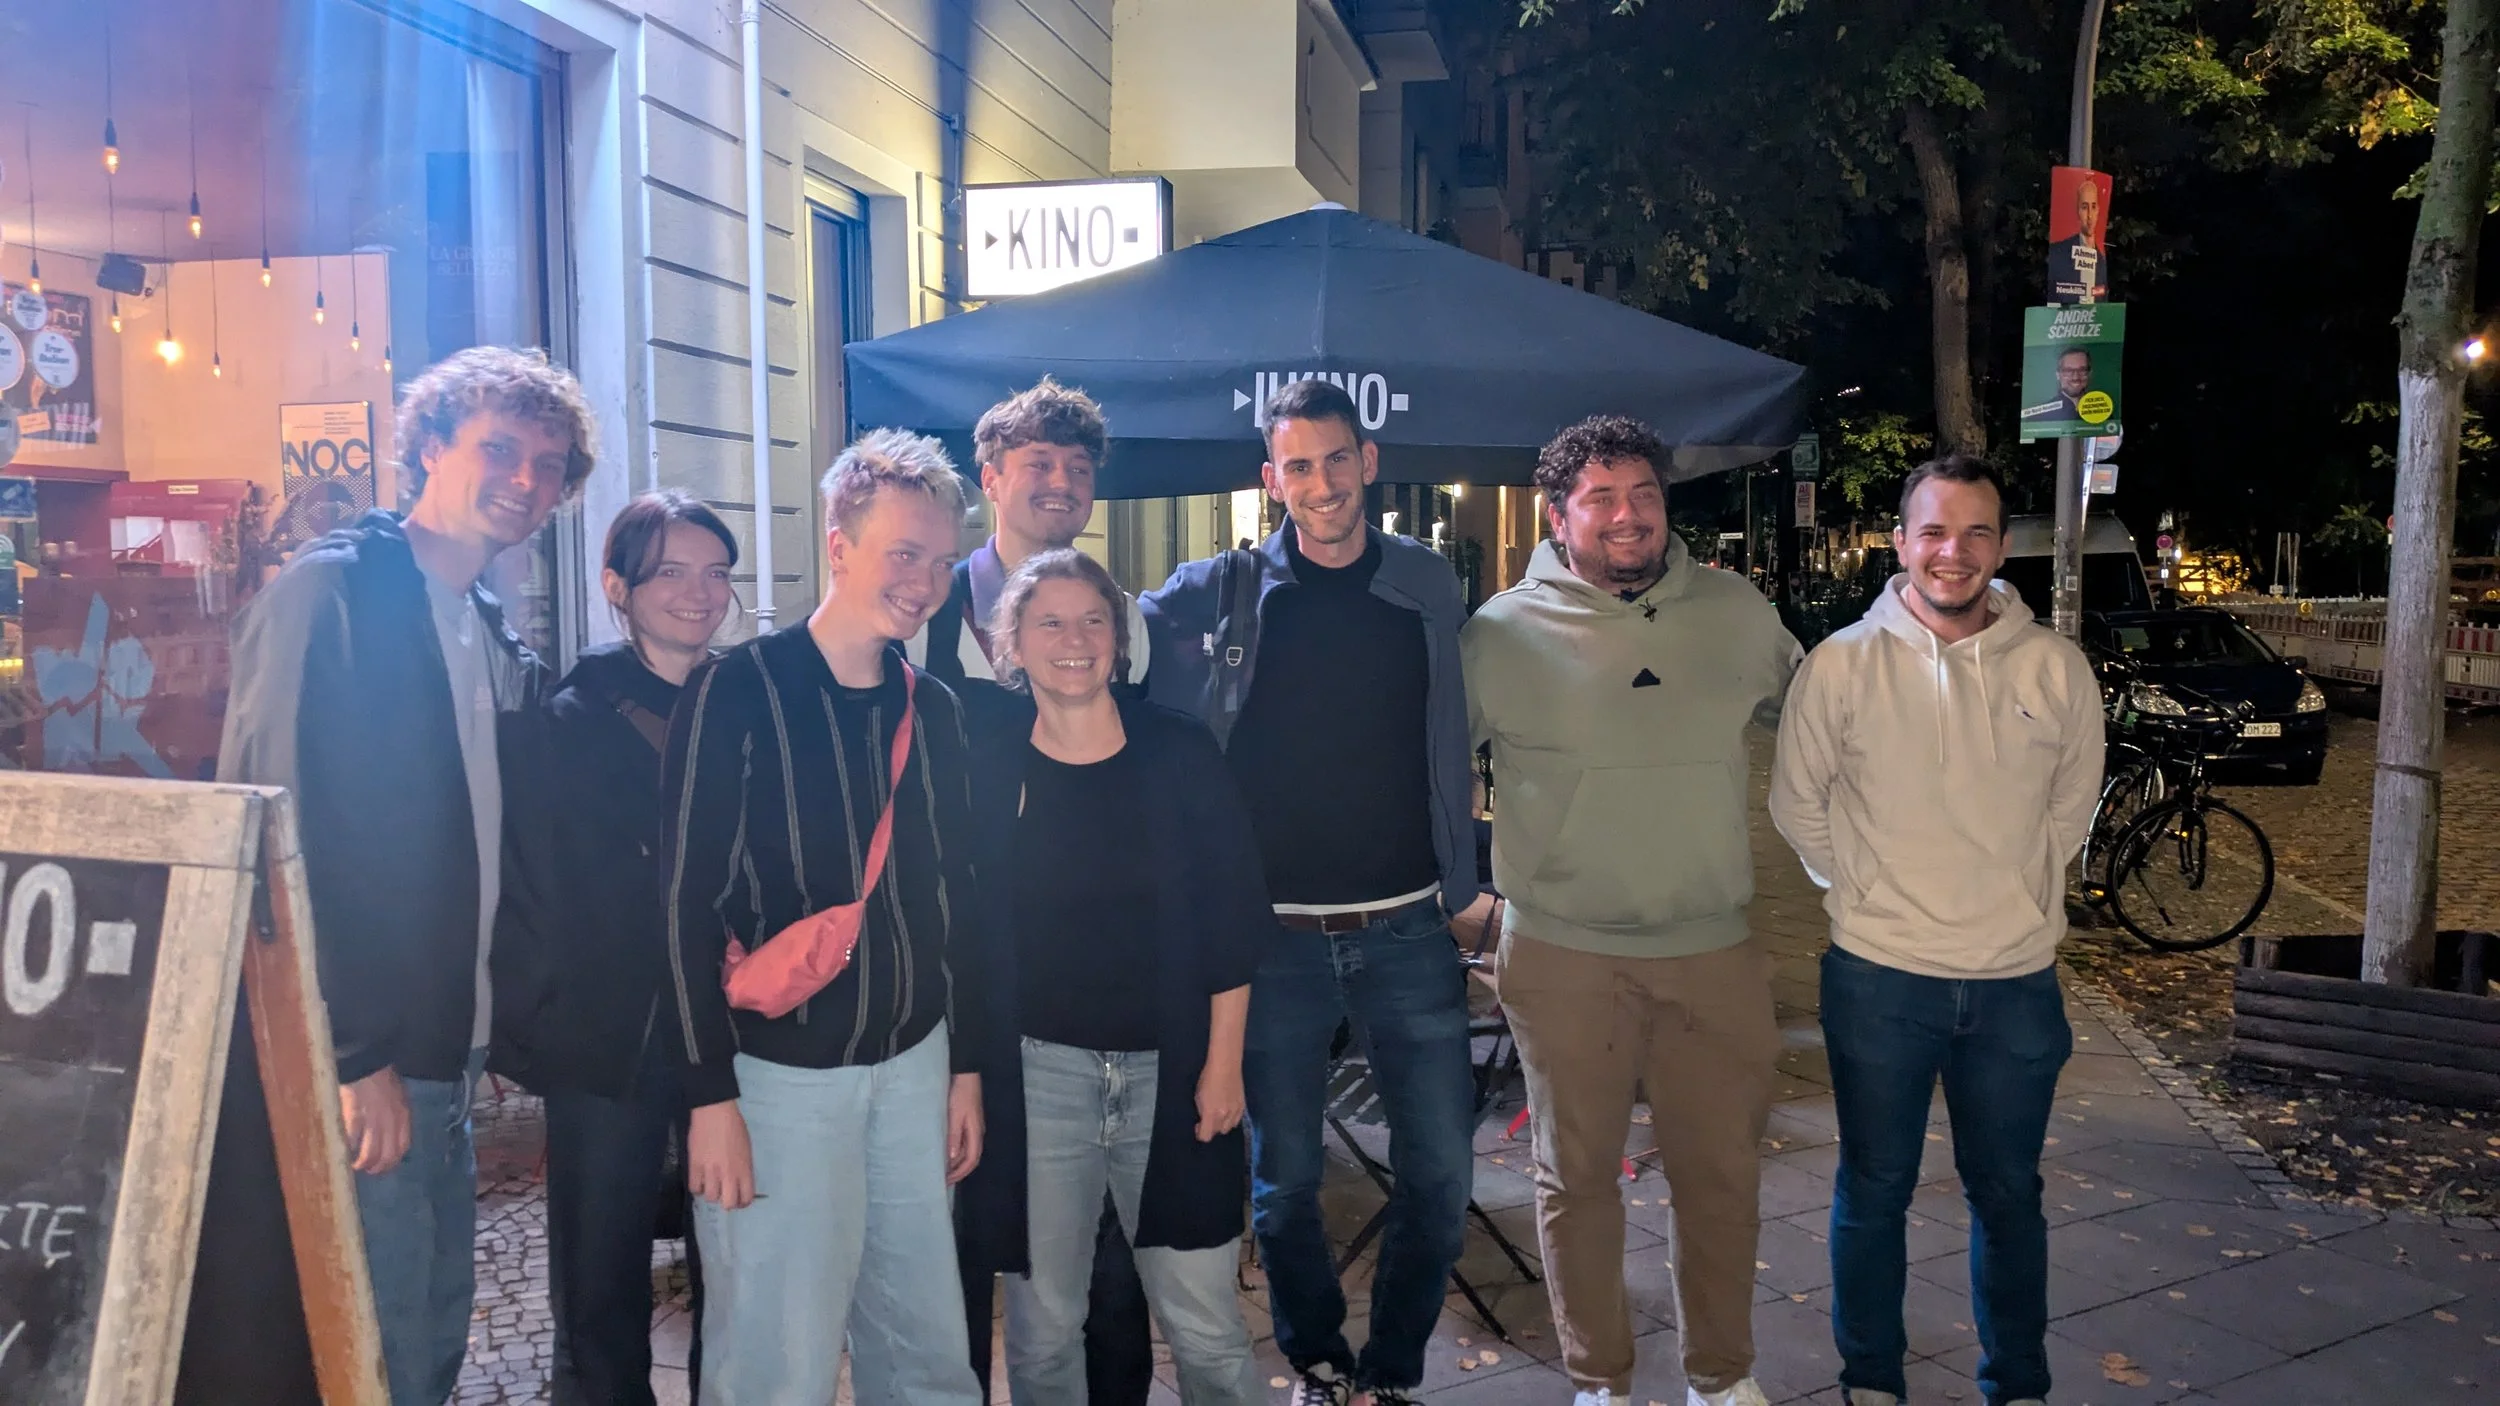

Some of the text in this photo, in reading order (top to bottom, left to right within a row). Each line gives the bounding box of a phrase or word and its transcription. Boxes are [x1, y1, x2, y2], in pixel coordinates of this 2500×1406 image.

[1007, 204, 1115, 271] KINO
[2054, 306, 2097, 324] ANDRÉ
[2048, 323, 2103, 339] SCHULZE
[283, 438, 370, 478] NOC
[2262, 725, 2280, 735] 222
[0, 861, 77, 1016] O
